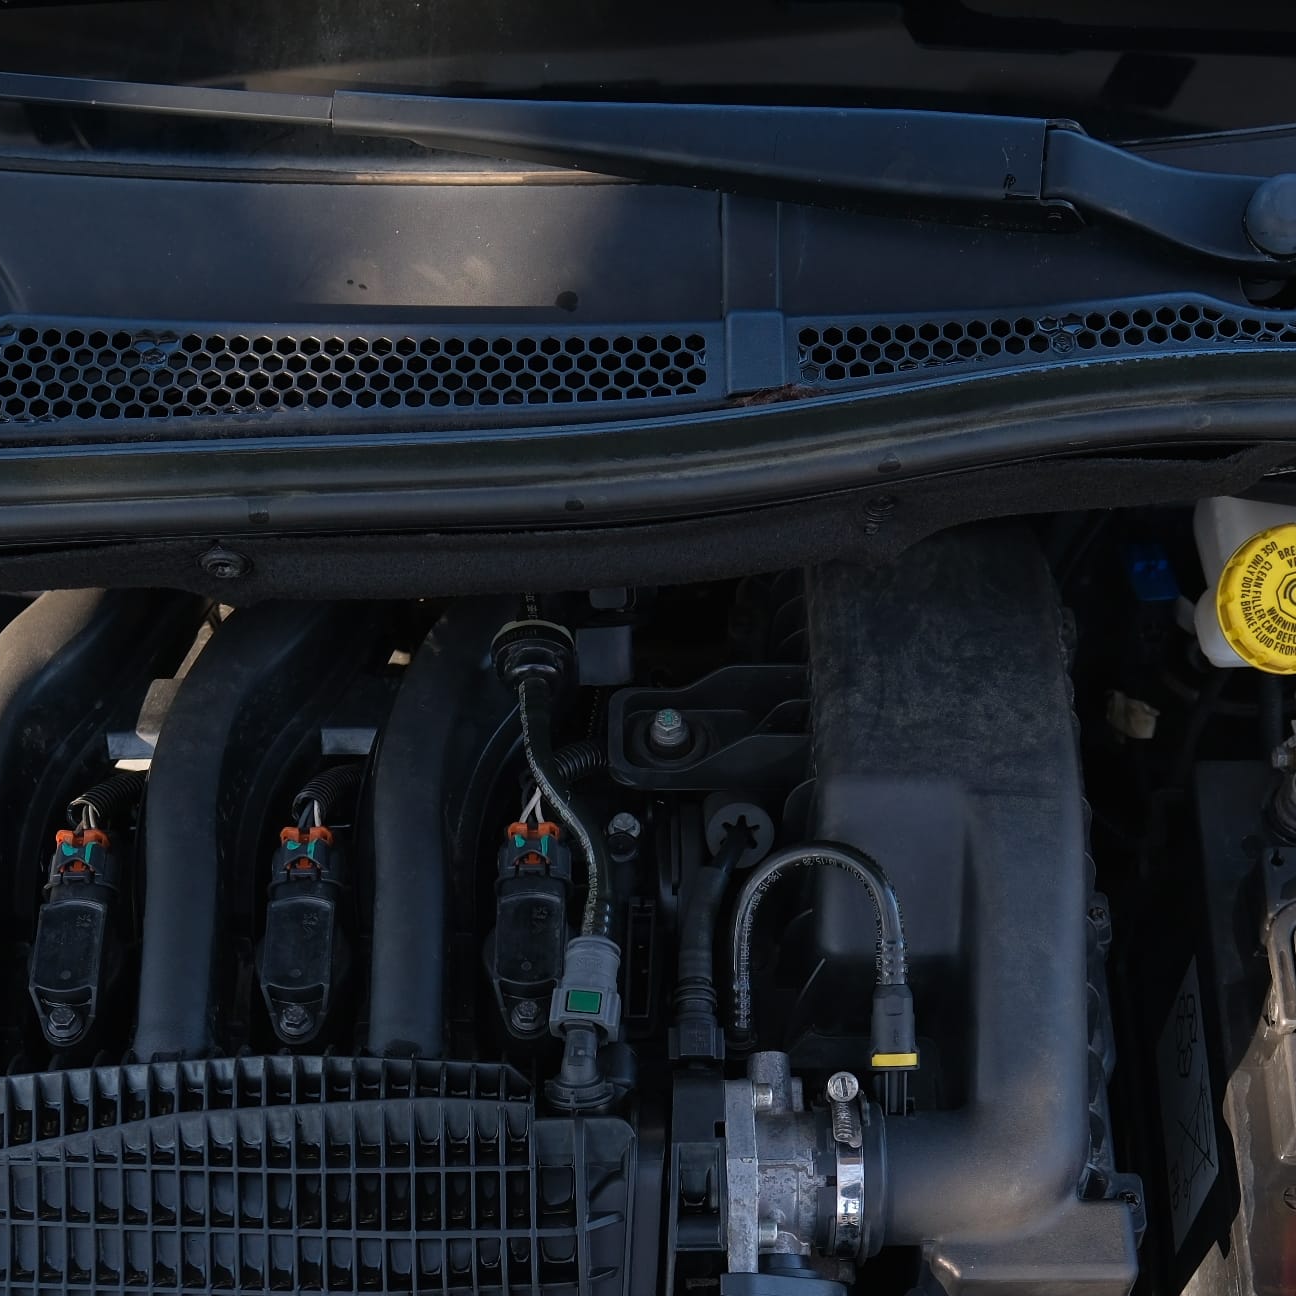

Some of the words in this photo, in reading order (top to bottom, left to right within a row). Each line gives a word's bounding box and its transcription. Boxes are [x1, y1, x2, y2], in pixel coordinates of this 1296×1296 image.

[1264, 541, 1278, 557] USE
[1246, 554, 1264, 576] ONLY
[1254, 562, 1273, 589] CLEAN
[1240, 601, 1257, 629] BRAKE
[1252, 590, 1266, 621] FILLER
[1252, 627, 1274, 649] FLUID
[1261, 619, 1277, 635] CAP
[1273, 644, 1296, 656] FROM
